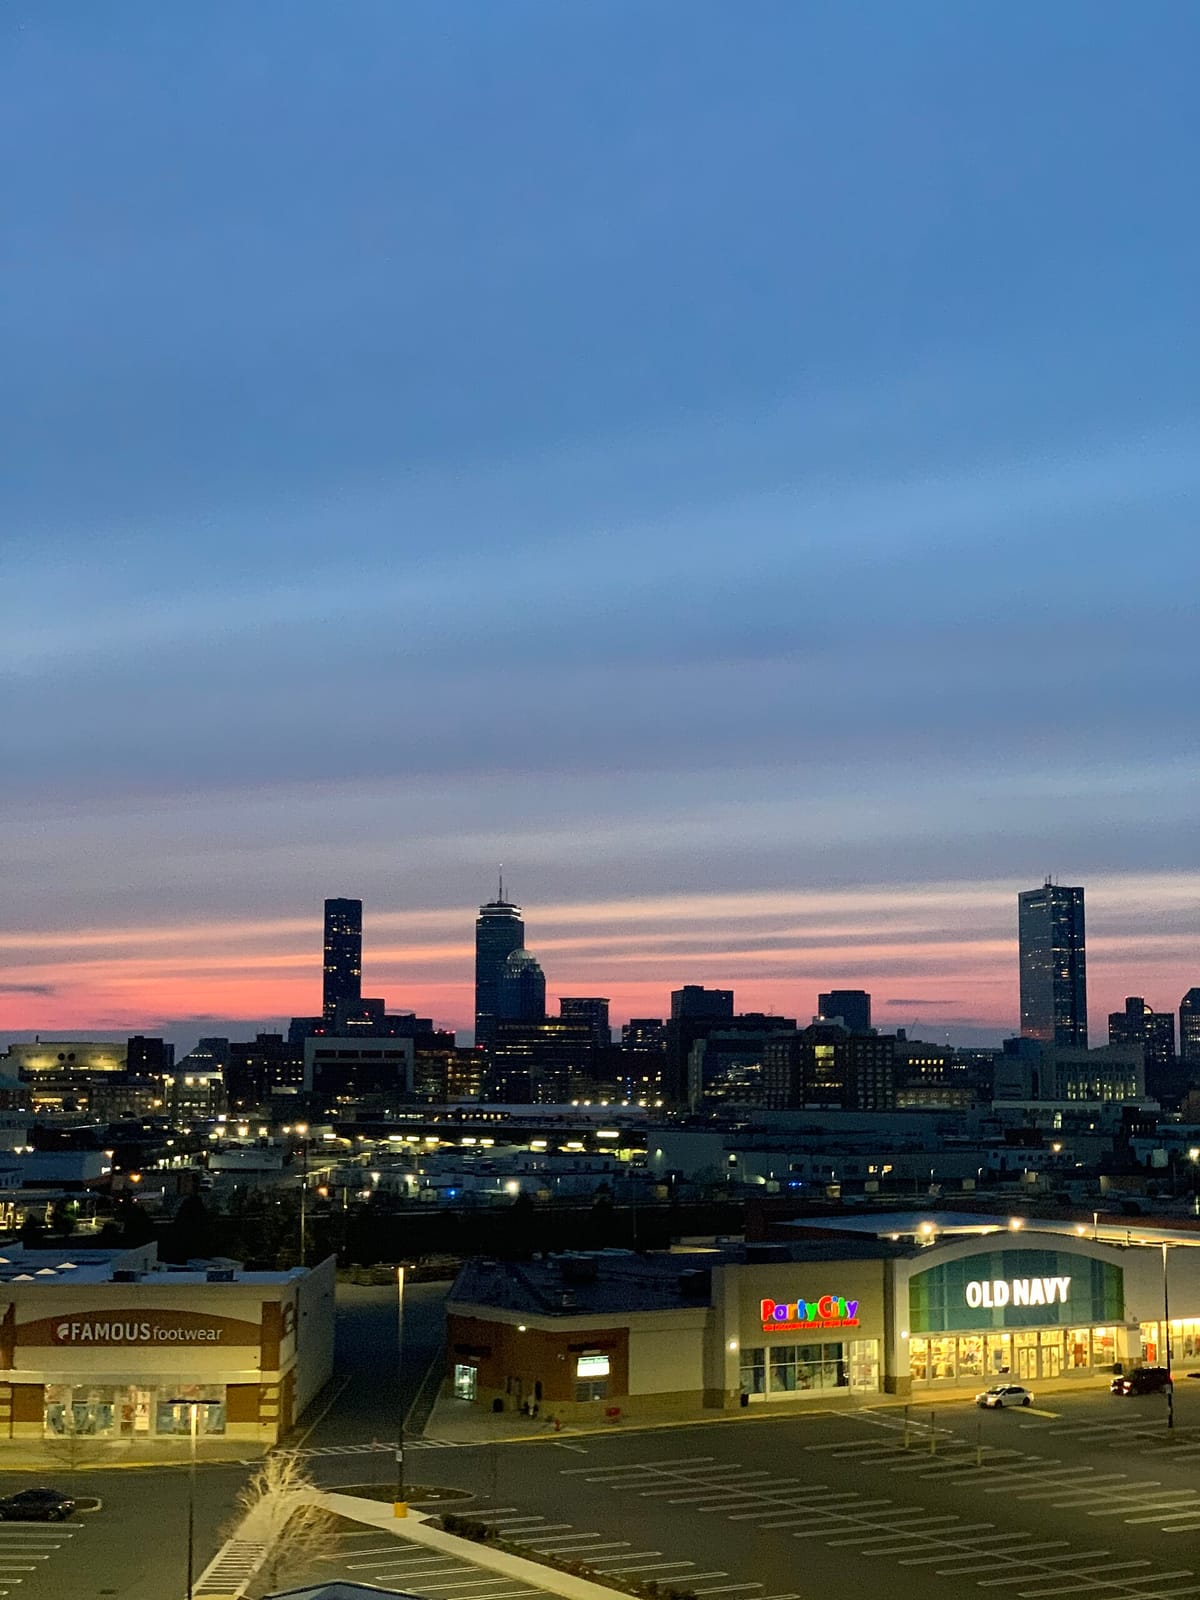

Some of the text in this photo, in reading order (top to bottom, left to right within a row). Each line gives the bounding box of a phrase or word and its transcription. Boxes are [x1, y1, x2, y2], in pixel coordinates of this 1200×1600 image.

[966, 1276, 1071, 1308] OLD NAVY
[71, 1322, 223, 1341] FAMOUS footwear
